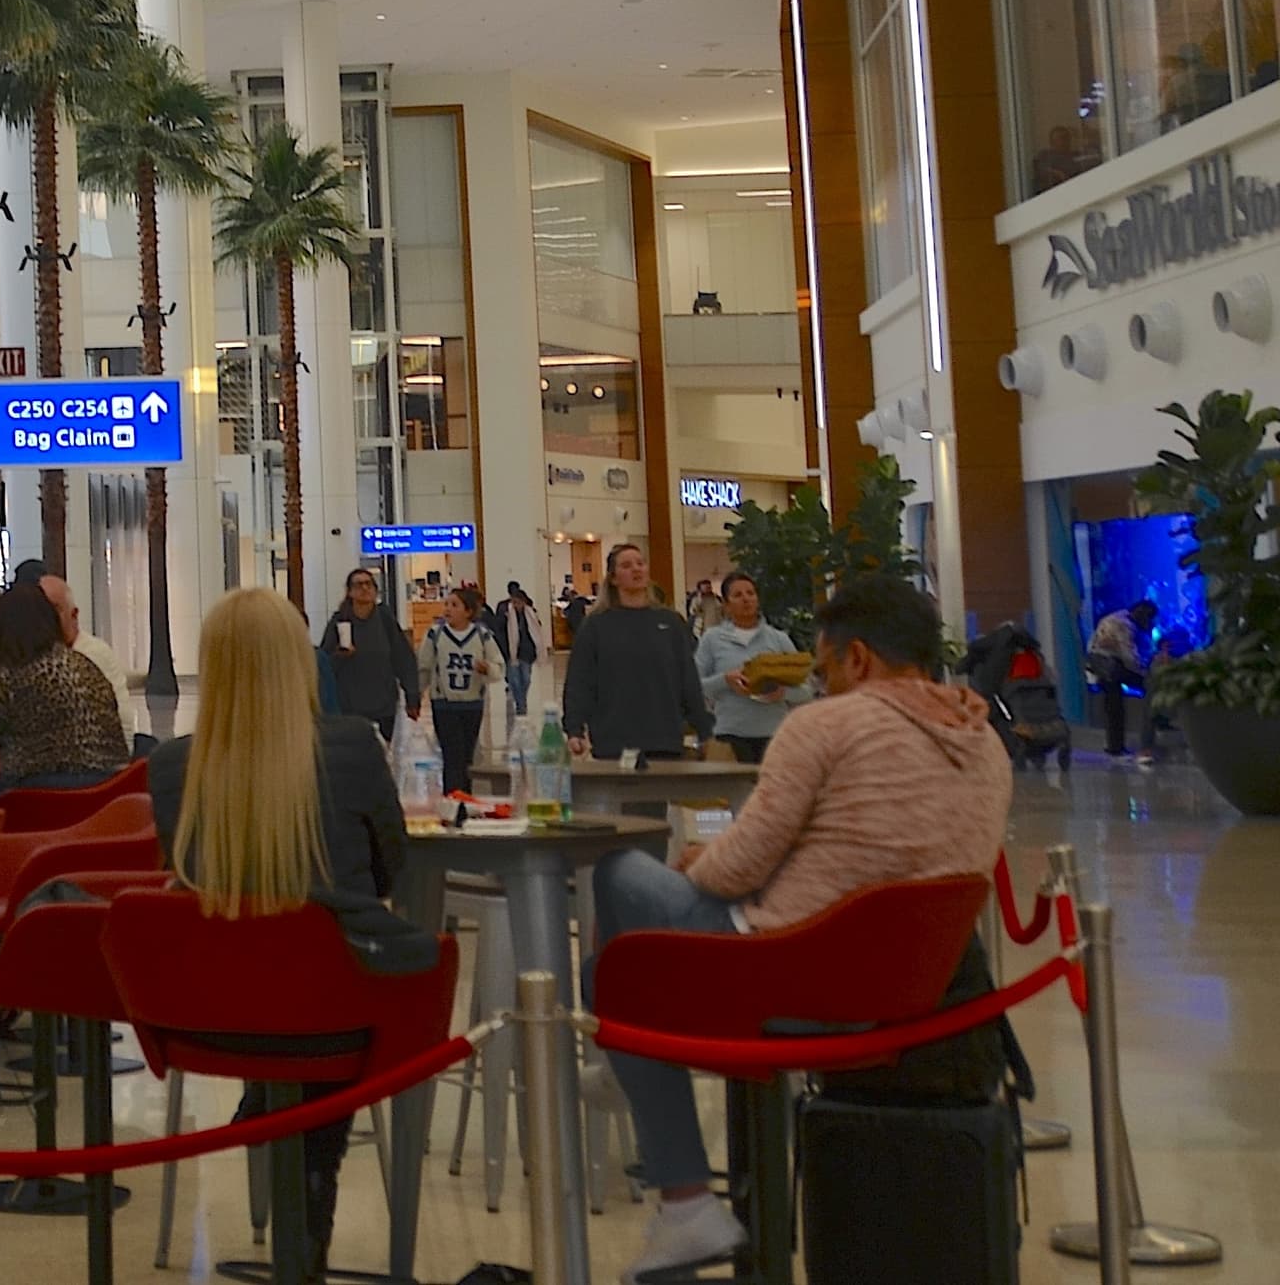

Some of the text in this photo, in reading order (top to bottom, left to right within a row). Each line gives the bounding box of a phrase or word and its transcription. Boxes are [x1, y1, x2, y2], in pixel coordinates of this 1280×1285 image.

[1085, 153, 1236, 289] SeaWorld
[7, 399, 109, 419] C250 C254
[14, 428, 111, 451] Bag Claim
[680, 479, 741, 507] HAKE SHACK
[448, 673, 472, 691] U
